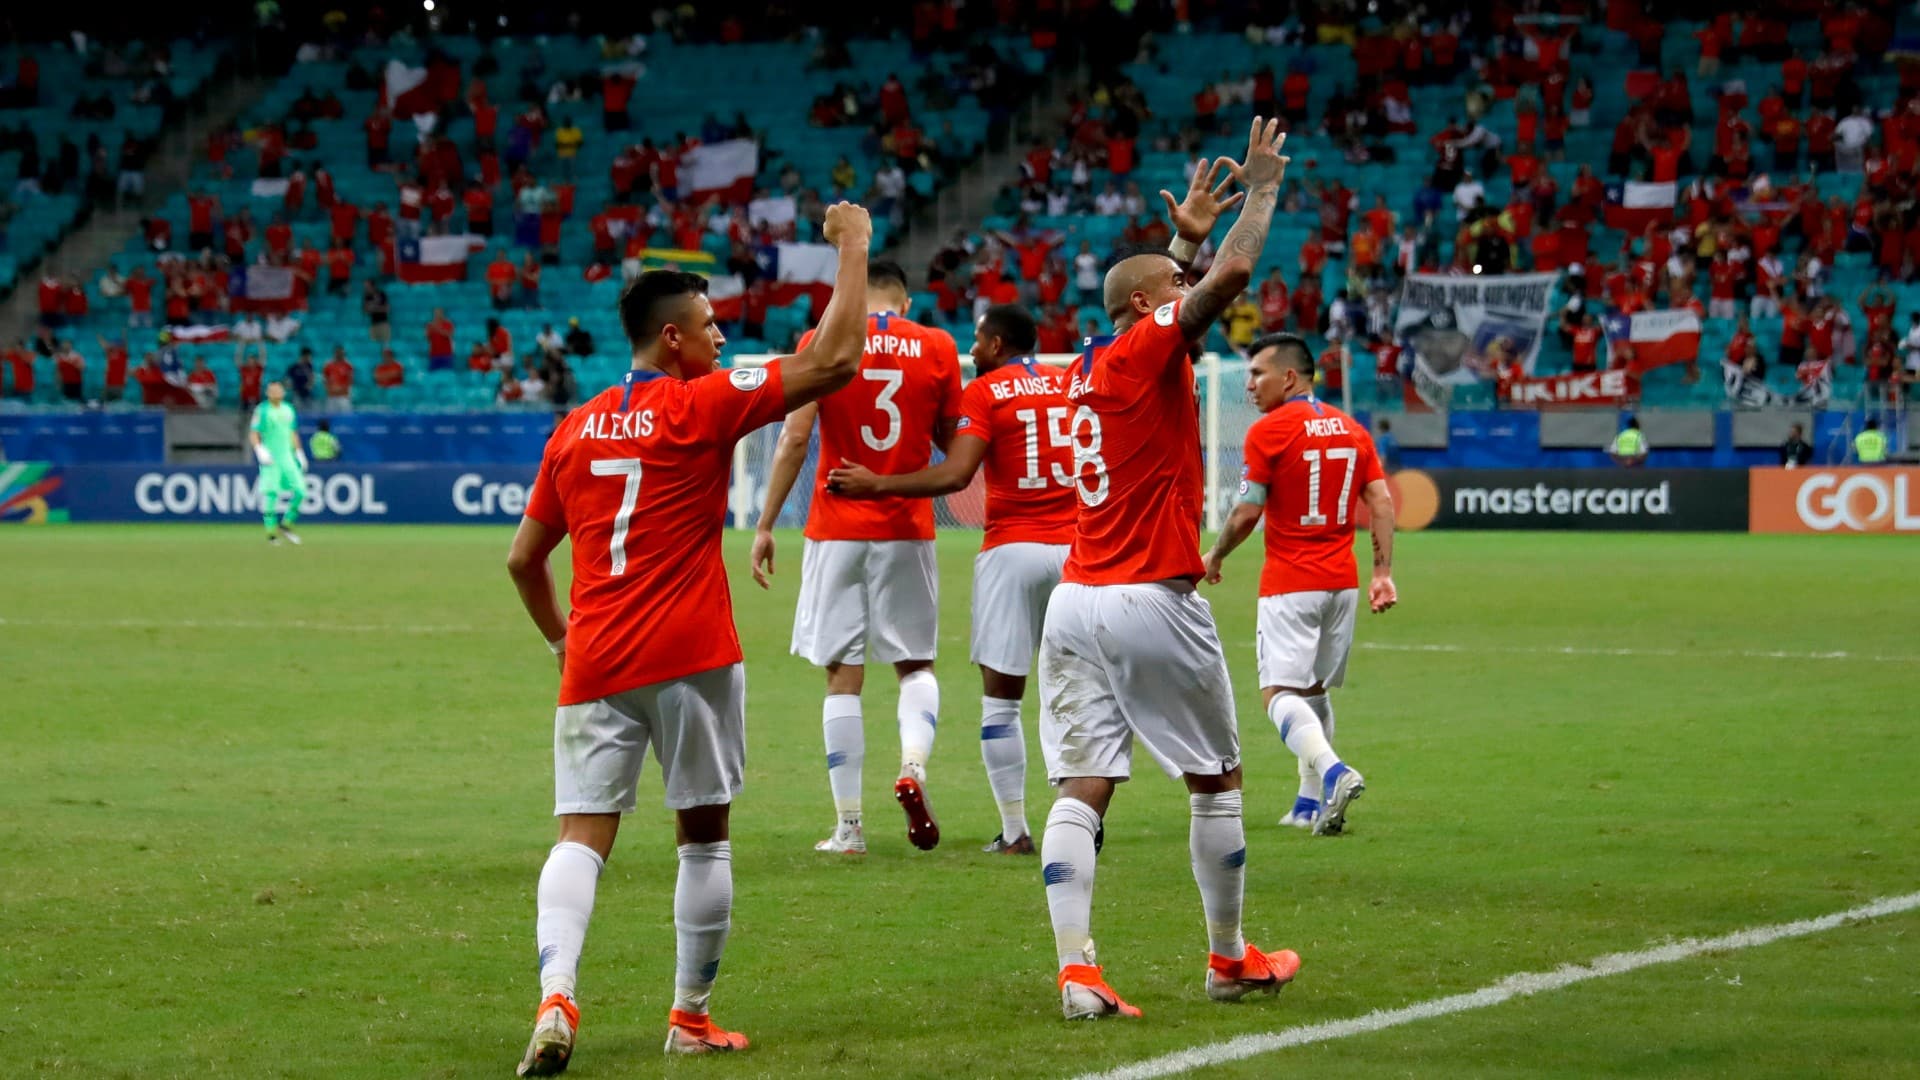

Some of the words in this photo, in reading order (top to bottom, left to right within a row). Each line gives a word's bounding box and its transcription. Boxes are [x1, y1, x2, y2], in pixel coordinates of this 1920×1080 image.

[863, 335, 921, 358] ARIPAN
[861, 369, 904, 451] 3
[989, 375, 1063, 400] BEAUSEJ
[1016, 407, 1075, 489] 15
[1071, 405, 1109, 507] 8
[1304, 416, 1351, 438] MEDEL
[452, 473, 535, 515] Cre
[1300, 447, 1357, 525] 17
[1455, 480, 1671, 515] mastercard
[1796, 472, 1920, 531] GOL
[590, 457, 642, 576] 7
